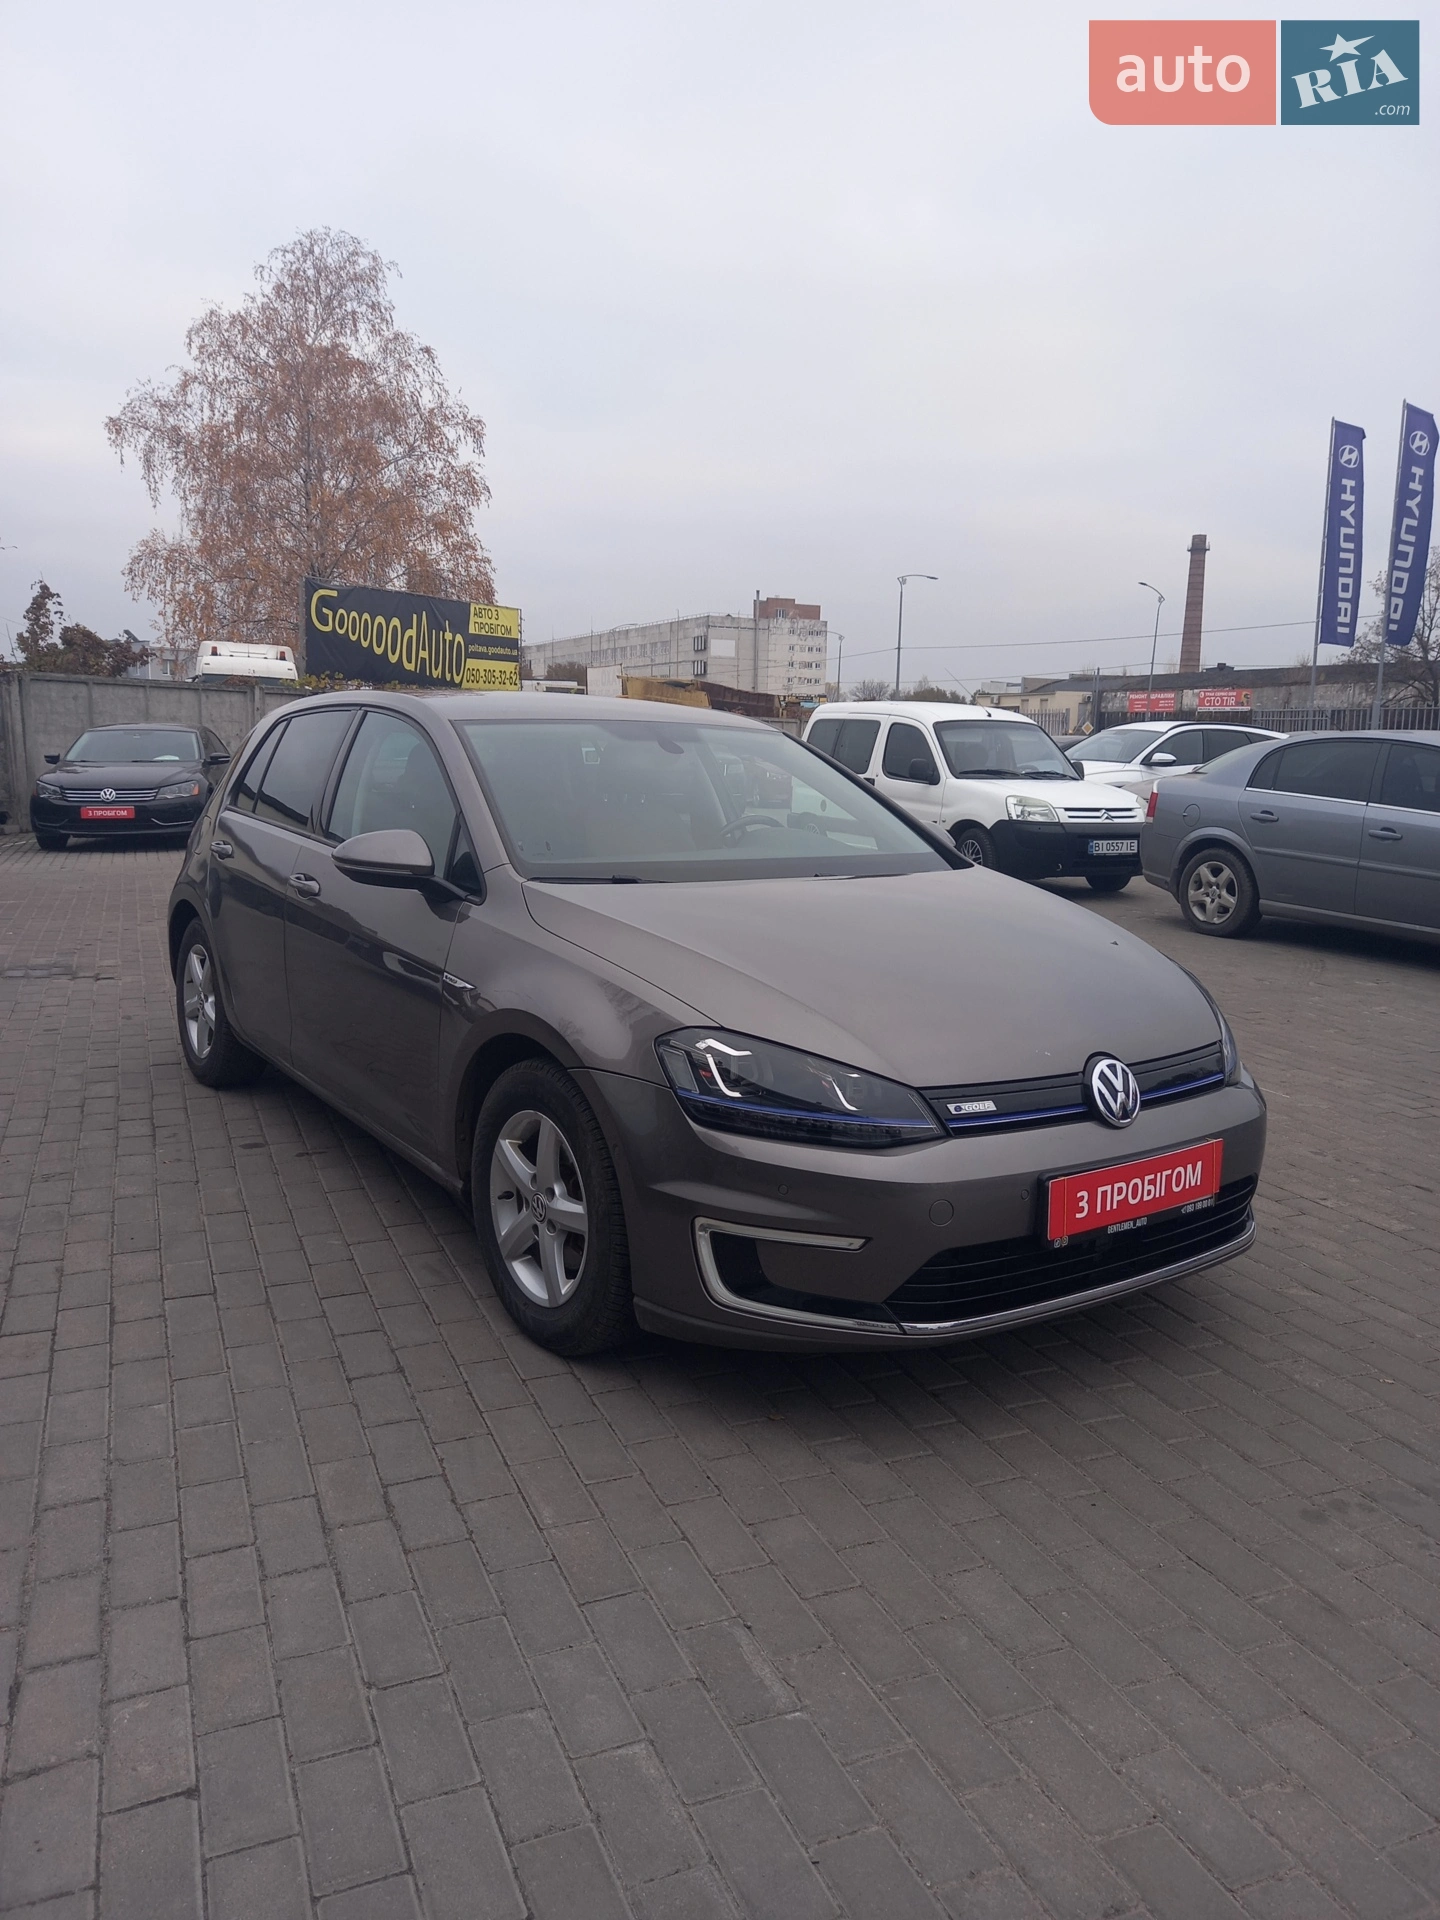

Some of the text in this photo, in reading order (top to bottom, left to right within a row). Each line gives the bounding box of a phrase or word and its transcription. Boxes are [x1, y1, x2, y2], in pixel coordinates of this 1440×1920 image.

[1337, 478, 1356, 634] HYUNDAI
[1388, 466, 1424, 631] HYUNDAI
[473, 606, 493, 620] АВТО
[473, 621, 512, 637] ПРОБІГОМ
[468, 643, 518, 656] poltava.goodauto.ua
[465, 667, 518, 687] 050-305-32-62
[1204, 696, 1221, 706] СТО
[1094, 842, 1135, 852] BI 0557 IE
[1096, 1160, 1203, 1215] ПРОБІГОМ
